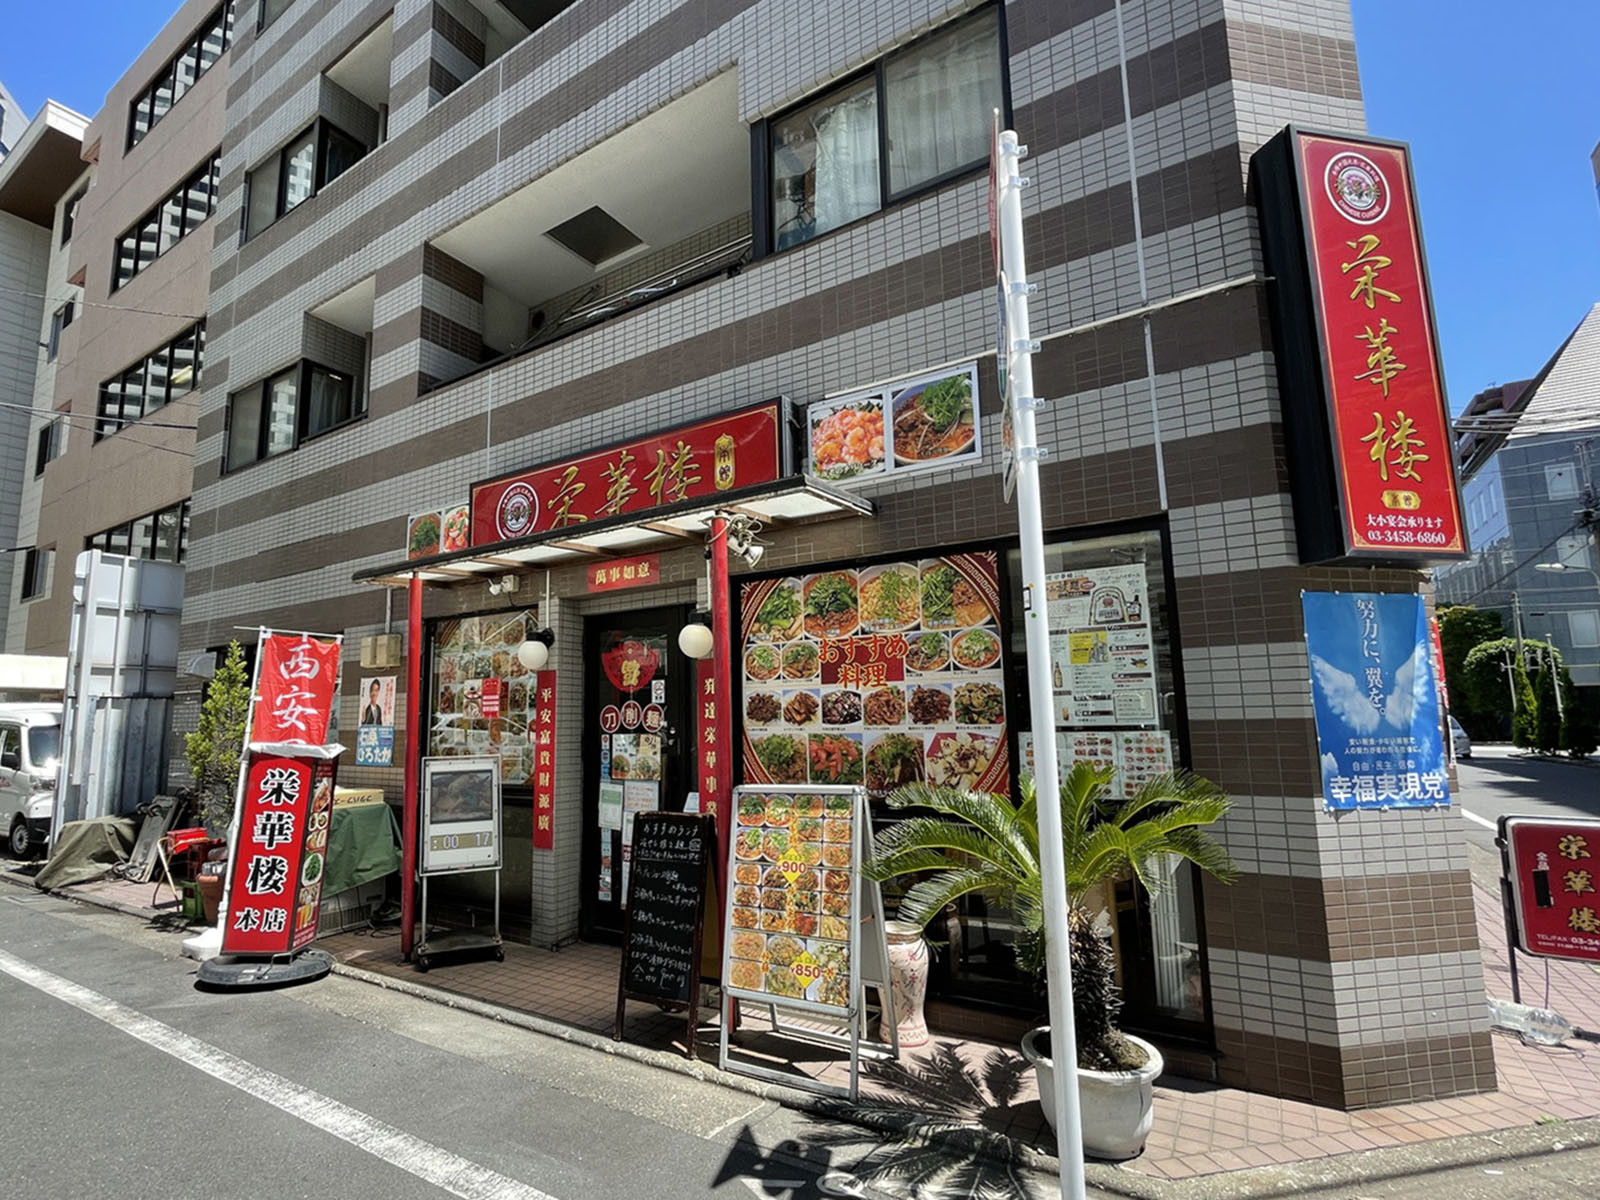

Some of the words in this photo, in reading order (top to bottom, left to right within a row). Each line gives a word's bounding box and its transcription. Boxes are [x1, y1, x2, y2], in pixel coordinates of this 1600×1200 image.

[1366, 513, 1442, 528] 大小宴会承ります
[1368, 530, 1445, 544] 03-3458-6860
[818, 633, 909, 662] おすすめ
[1357, 599, 1386, 716] 努力に、翼を。
[838, 663, 888, 689] 料理
[272, 644, 320, 746] 西安
[358, 747, 392, 763] ひろたか
[1329, 773, 1444, 804] 幸福実現党
[246, 768, 300, 895] 栄華楼
[234, 907, 288, 933] 本店
